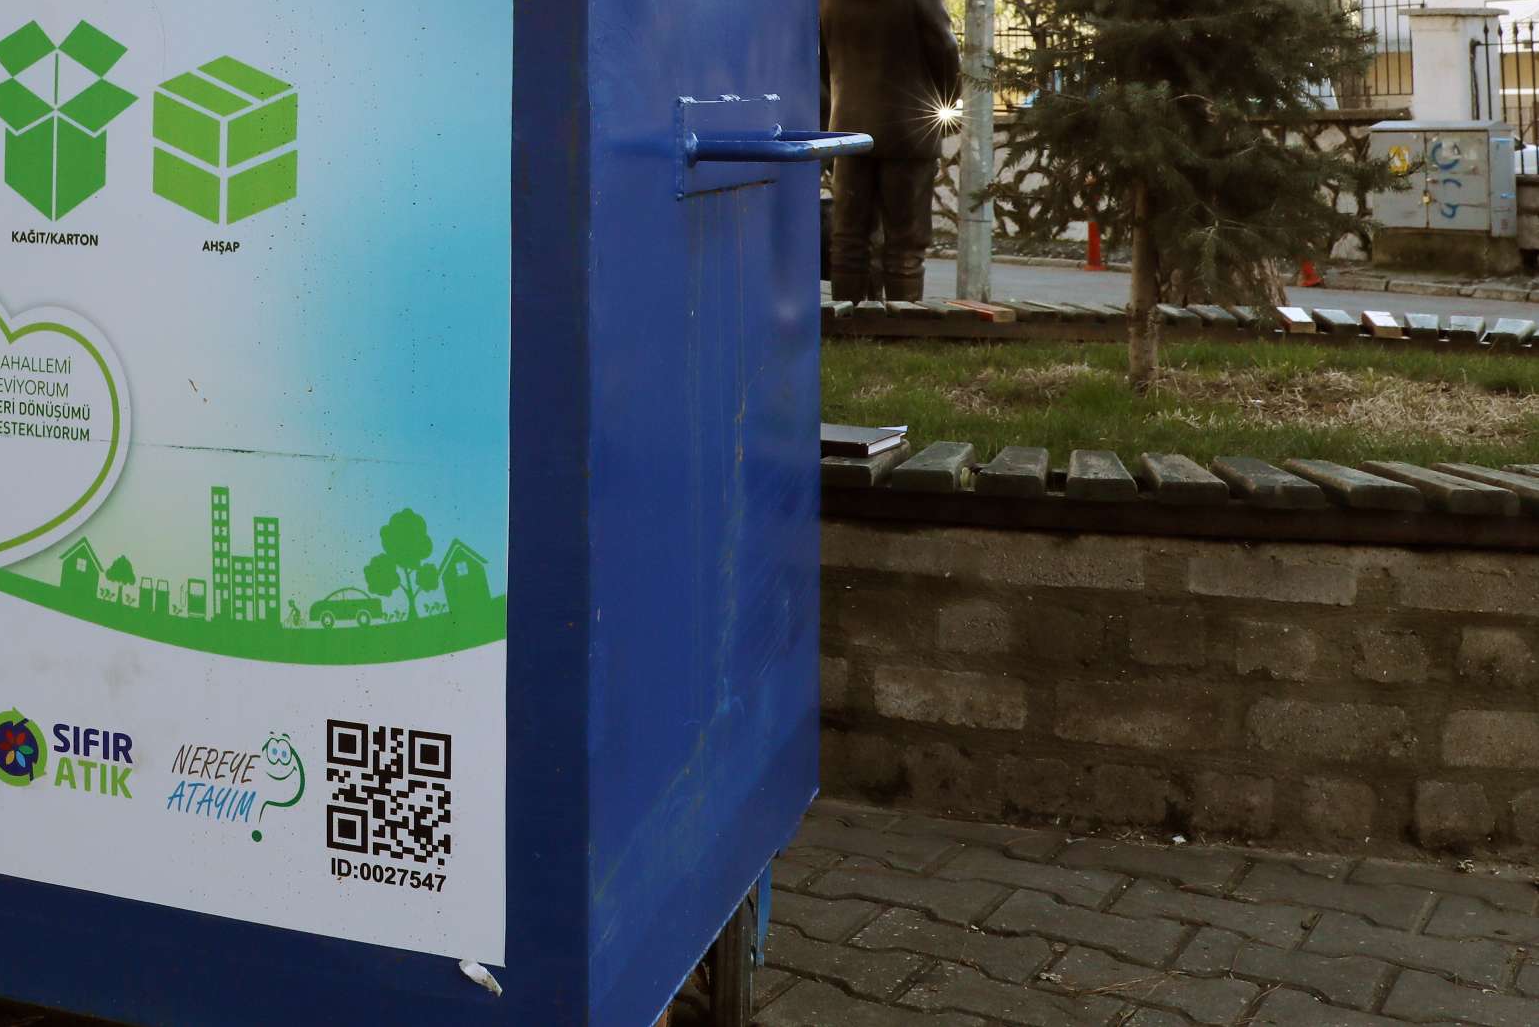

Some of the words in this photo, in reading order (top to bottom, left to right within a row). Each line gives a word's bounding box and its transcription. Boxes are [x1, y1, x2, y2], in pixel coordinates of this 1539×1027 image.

[11, 229, 99, 247] KAĞIT/KARTON
[202, 239, 241, 255] AHŞAP
[19, 401, 91, 423] DÖNÜŞÜMÜ
[53, 723, 134, 764] SIFIR
[53, 756, 134, 800] ATIK
[171, 743, 261, 784] NEREYE
[166, 780, 257, 824] ATAYIM
[331, 857, 447, 893] ID:0027547
